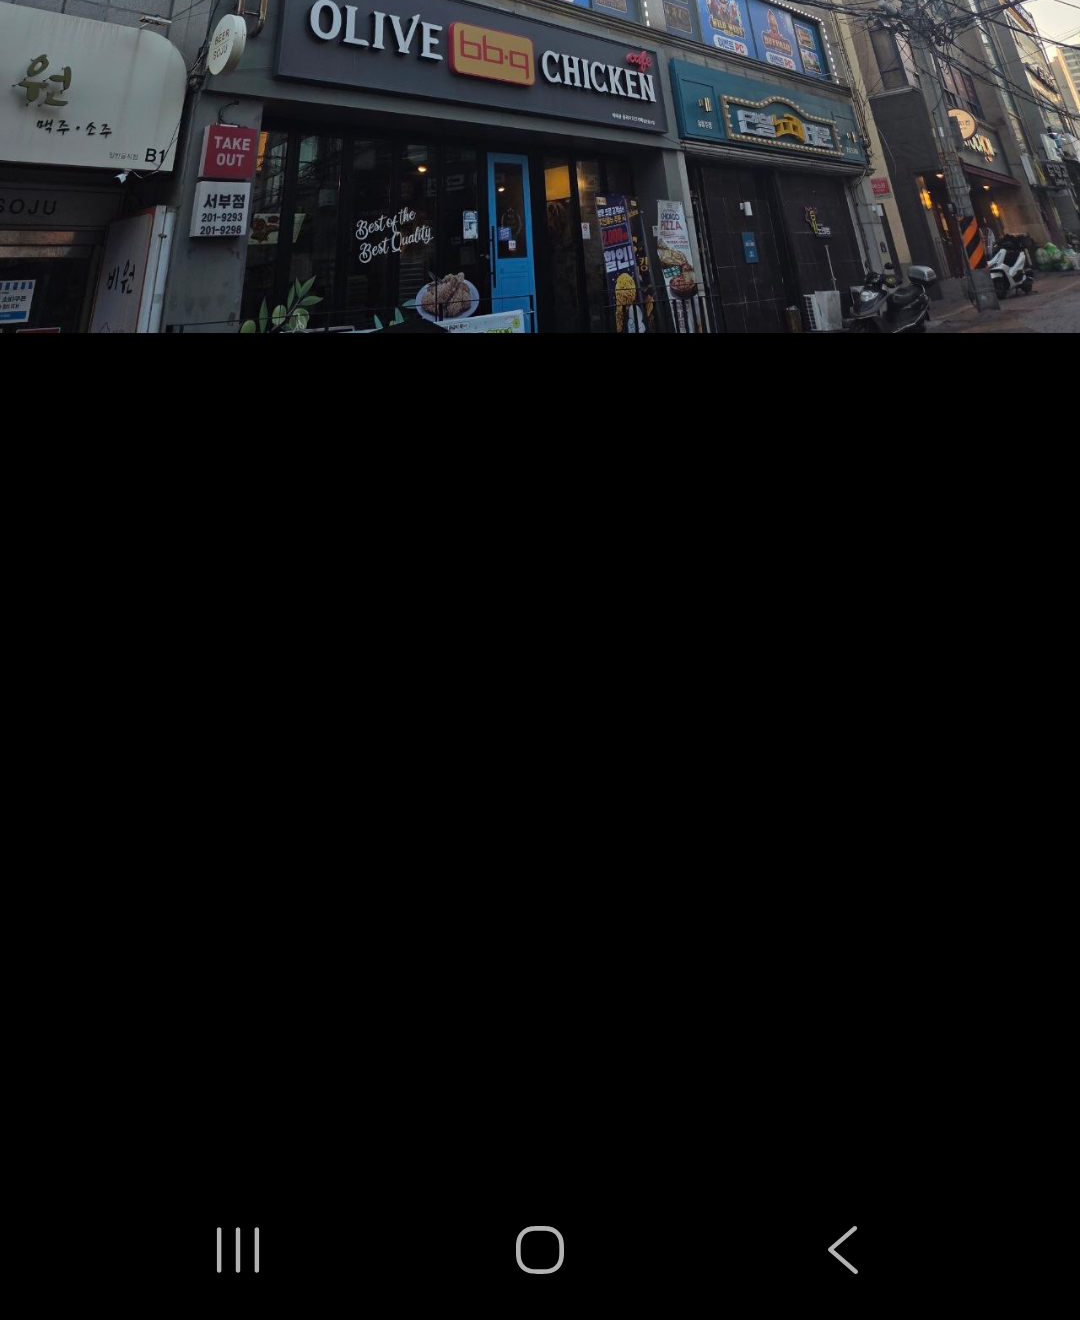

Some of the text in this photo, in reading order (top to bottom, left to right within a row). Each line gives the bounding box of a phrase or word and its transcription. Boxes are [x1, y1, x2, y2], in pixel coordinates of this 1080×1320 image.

[215, 29, 230, 45] BEER
[213, 44, 228, 60] SOJU
[18, 54, 72, 107] 원
[541, 50, 657, 103] CHICKEN
[214, 135, 251, 151] TAKE
[145, 148, 165, 163] B1
[216, 153, 245, 167] OUT
[204, 194, 246, 209] 서부점
[201, 212, 243, 223] 201-9293
[356, 207, 416, 240] Best of the
[661, 212, 680, 221] CHICAGO
[200, 225, 242, 235] 201-9298
[661, 220, 683, 231] PIZZA
[359, 225, 434, 264] Best Quality
[604, 245, 635, 273] 할인!
[107, 259, 136, 295] 비원
